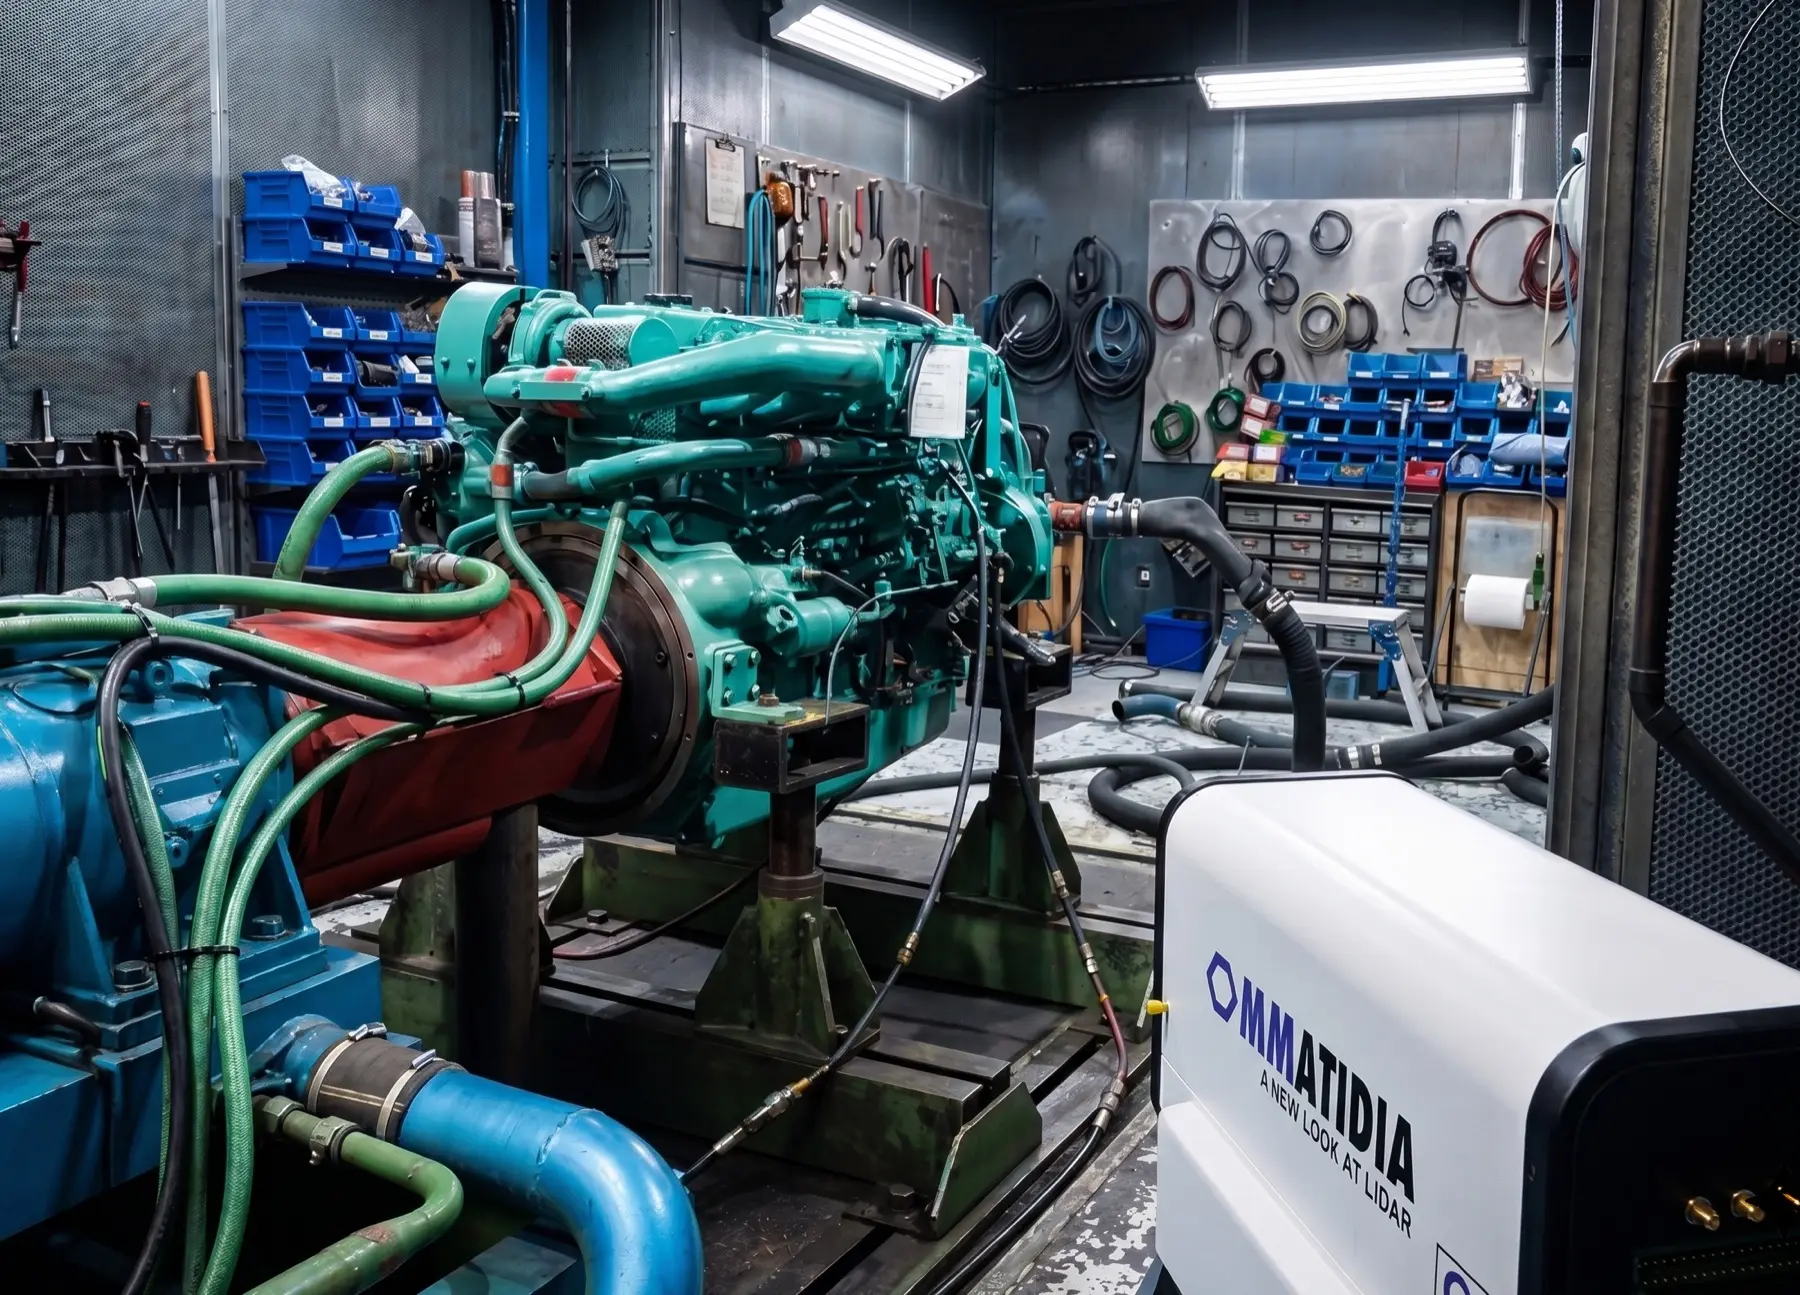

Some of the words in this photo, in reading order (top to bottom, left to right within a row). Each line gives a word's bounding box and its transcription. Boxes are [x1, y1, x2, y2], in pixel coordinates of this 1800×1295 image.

[1260, 1068, 1269, 1093] A
[1271, 1077, 1300, 1123] NEW
[1302, 1109, 1339, 1165] LOOK
[1342, 1151, 1362, 1185] AT
[1364, 1171, 1412, 1239] LIDAR
